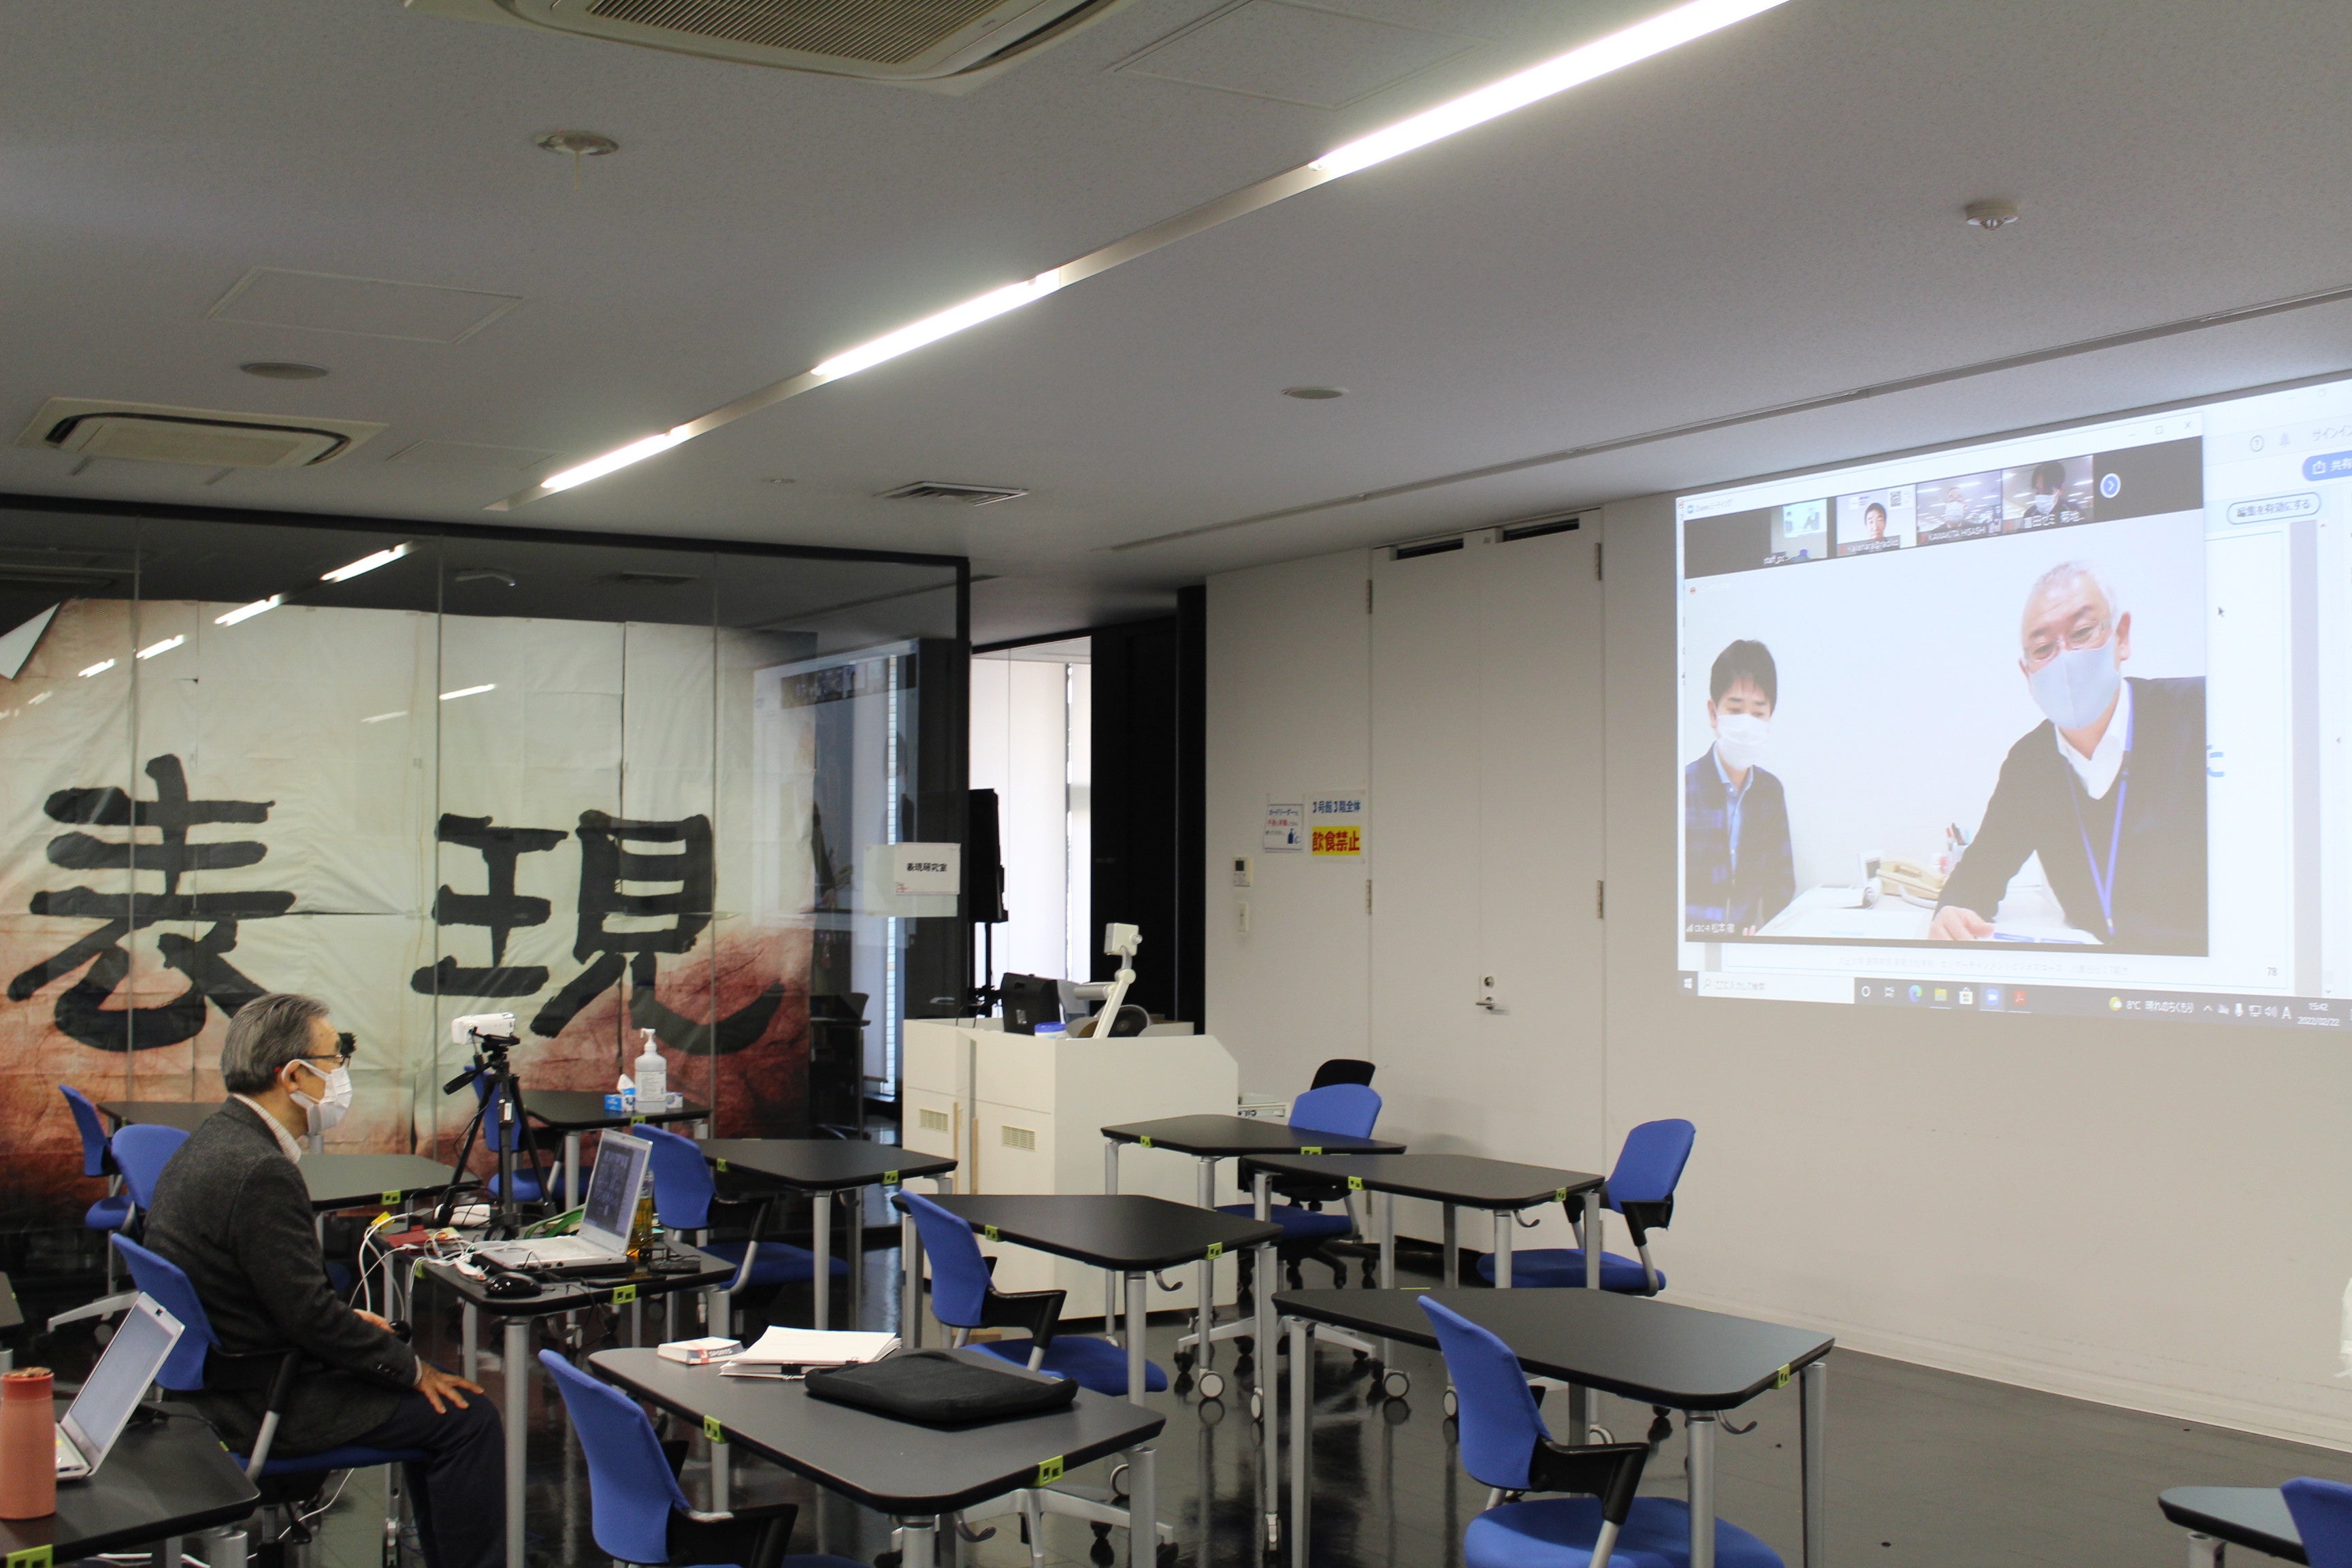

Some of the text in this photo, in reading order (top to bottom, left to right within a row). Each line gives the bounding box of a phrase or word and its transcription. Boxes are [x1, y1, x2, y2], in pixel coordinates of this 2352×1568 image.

[1312, 830, 1360, 851] 飲食禁止
[2266, 966, 2278, 976] 78
[2297, 1016, 2340, 1026] 2022/02/22
